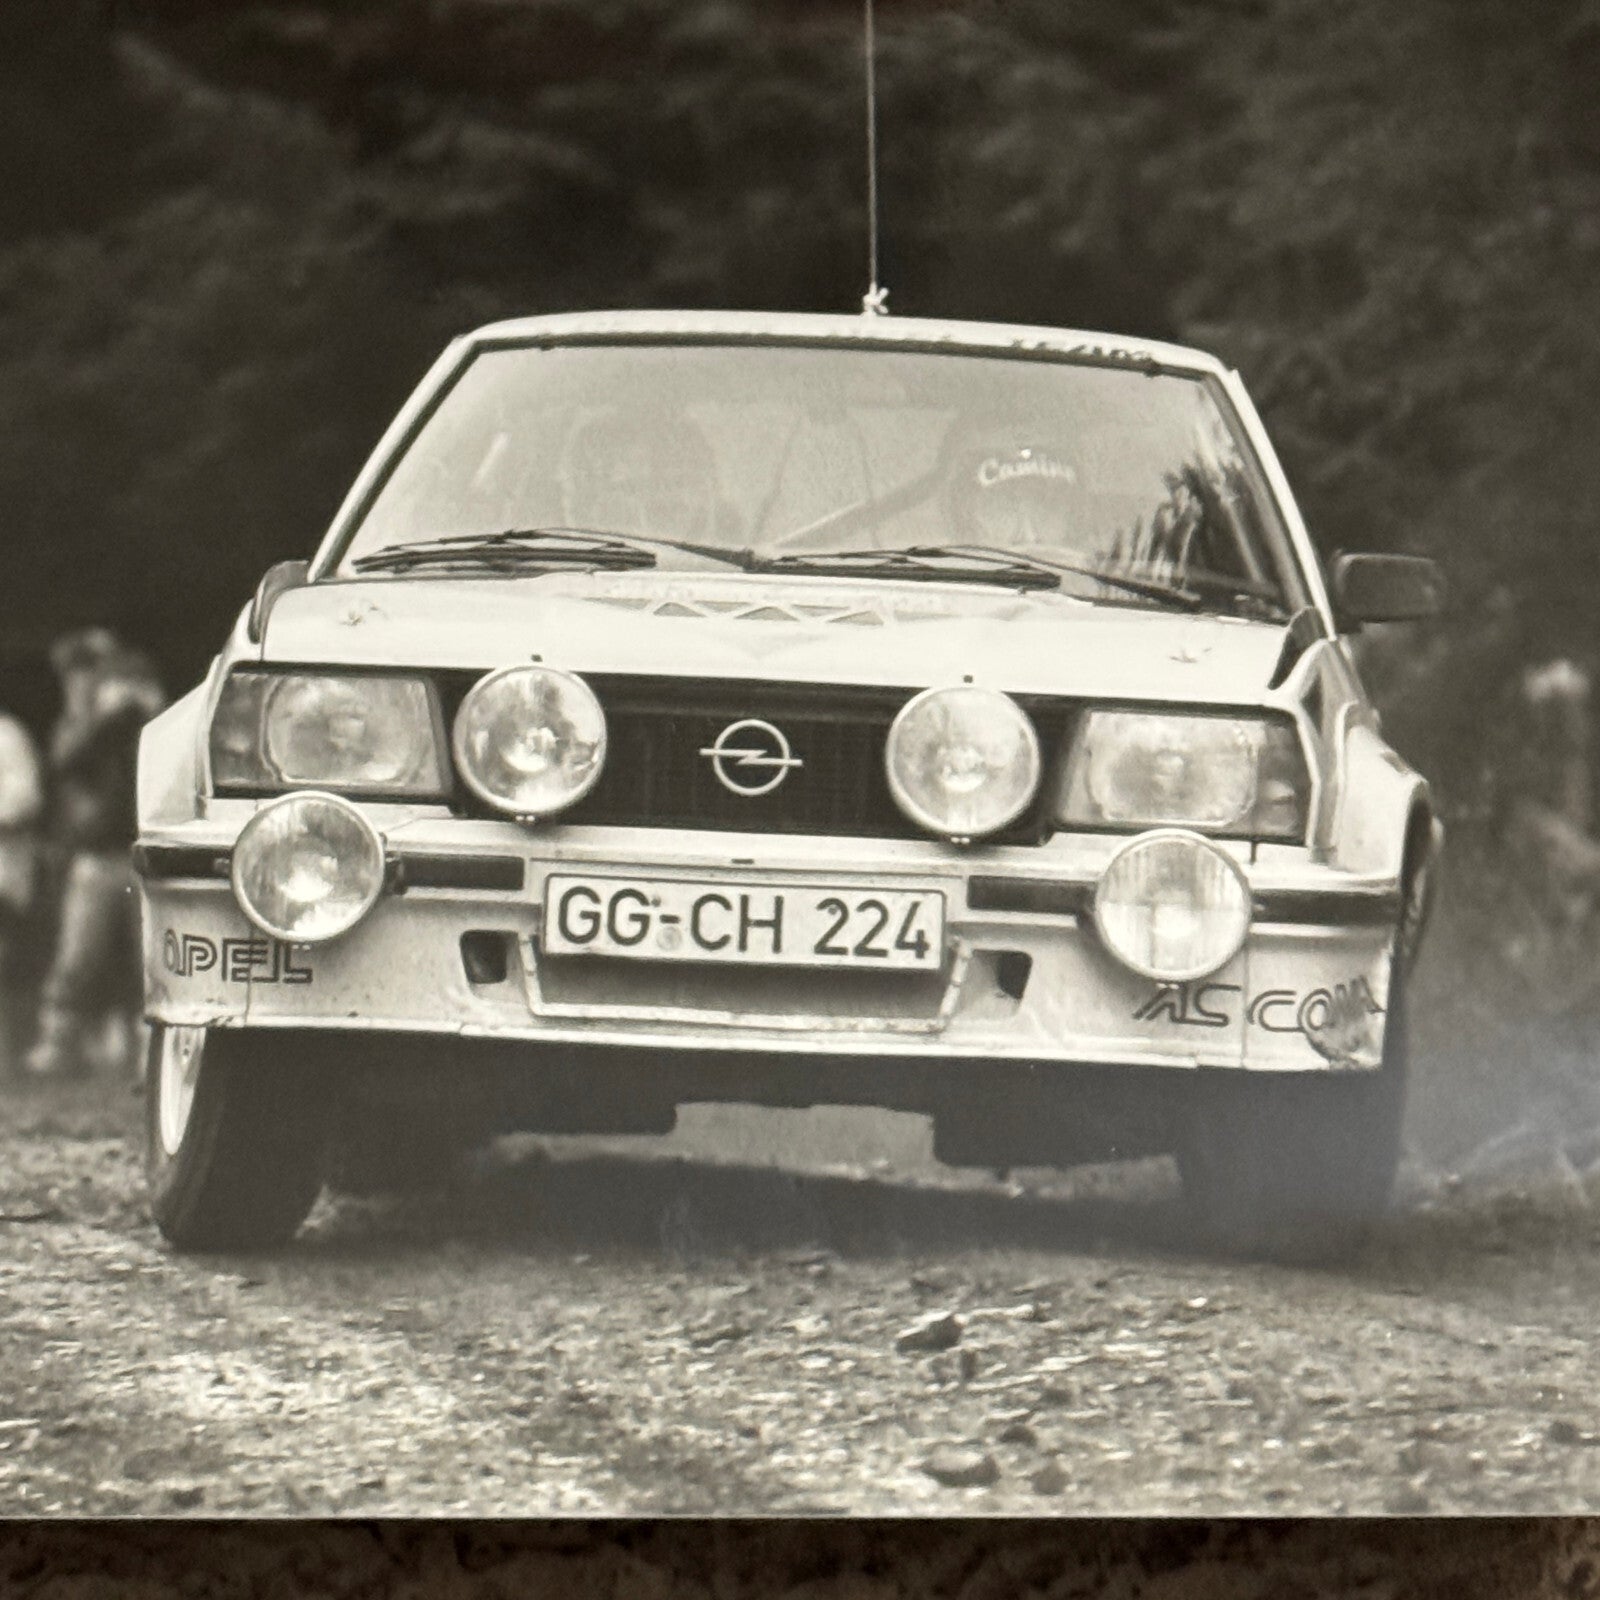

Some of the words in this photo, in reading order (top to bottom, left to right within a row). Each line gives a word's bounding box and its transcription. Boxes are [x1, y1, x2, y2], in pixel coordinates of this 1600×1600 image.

[558, 885, 784, 953] GG-CH
[813, 897, 931, 959] 224
[163, 929, 314, 984] OPEL
